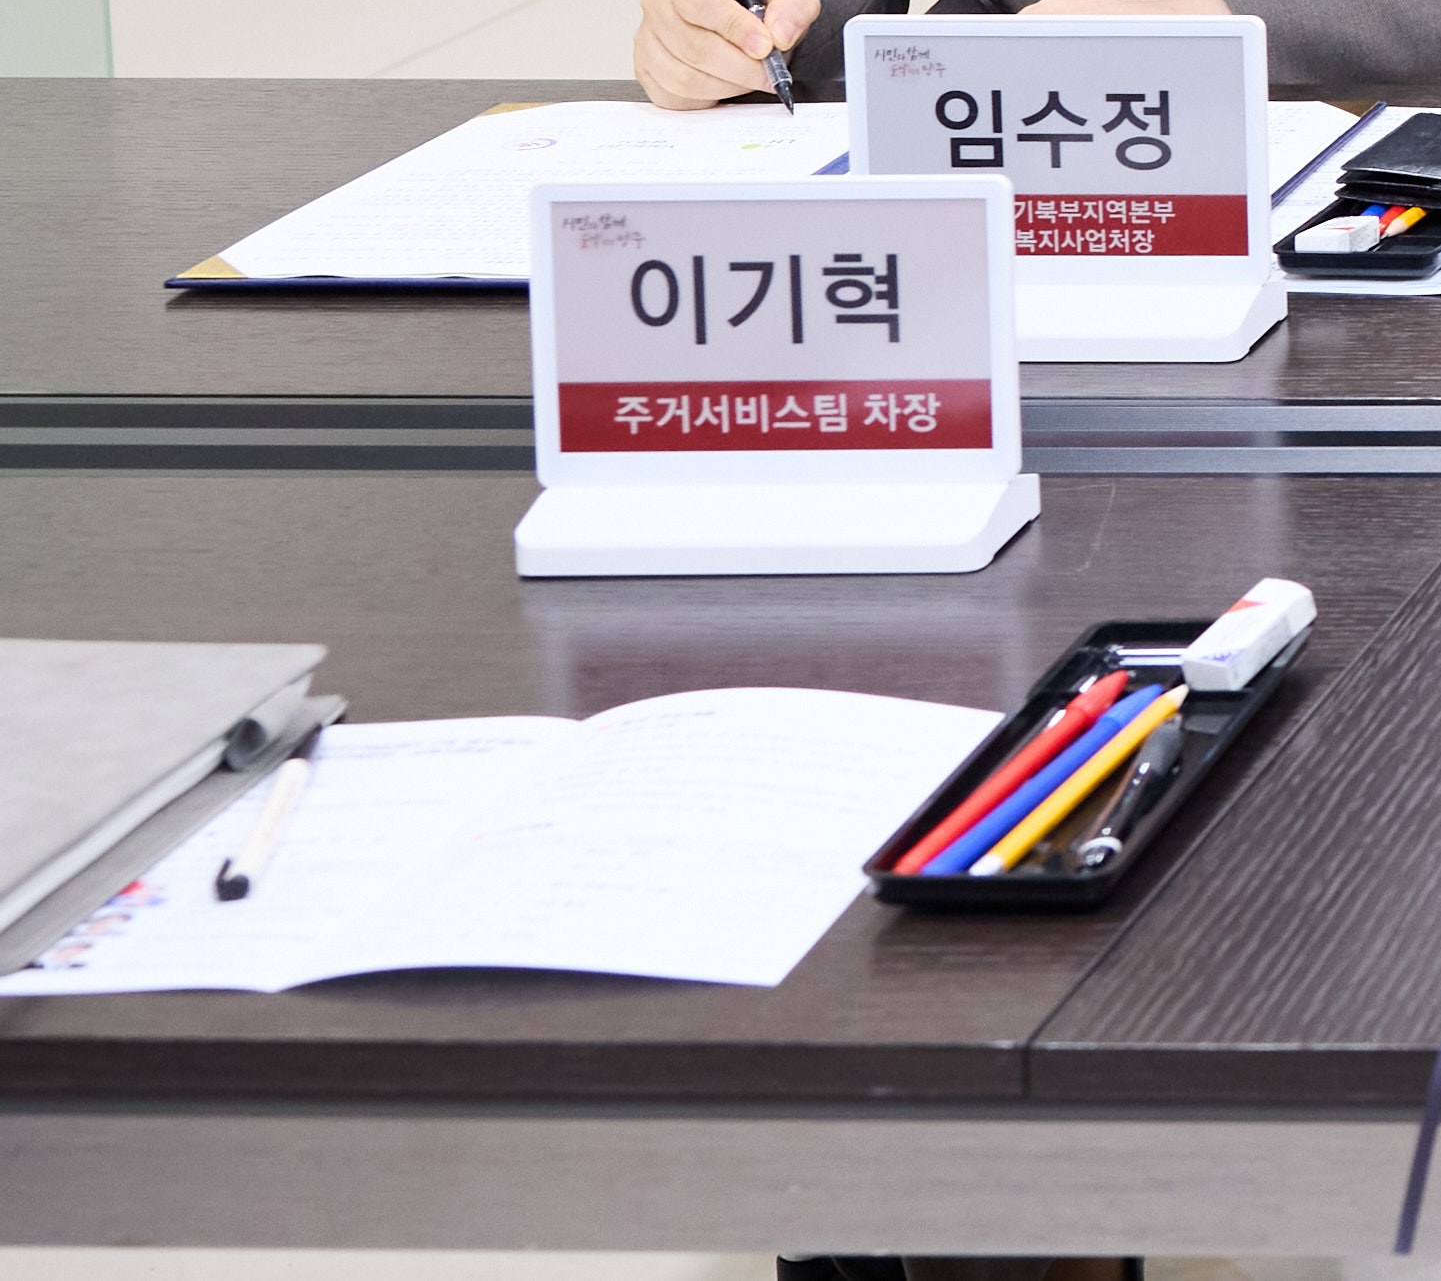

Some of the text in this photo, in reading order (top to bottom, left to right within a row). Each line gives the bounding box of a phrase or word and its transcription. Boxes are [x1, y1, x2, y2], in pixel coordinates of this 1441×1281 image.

[935, 90, 1171, 170] 임수정
[1014, 200, 1176, 224] 기북부지역본부
[1014, 228, 1155, 254] 복지사업처장
[630, 253, 899, 345] 이기혁
[615, 392, 942, 434] 주거서비스팀 차장
